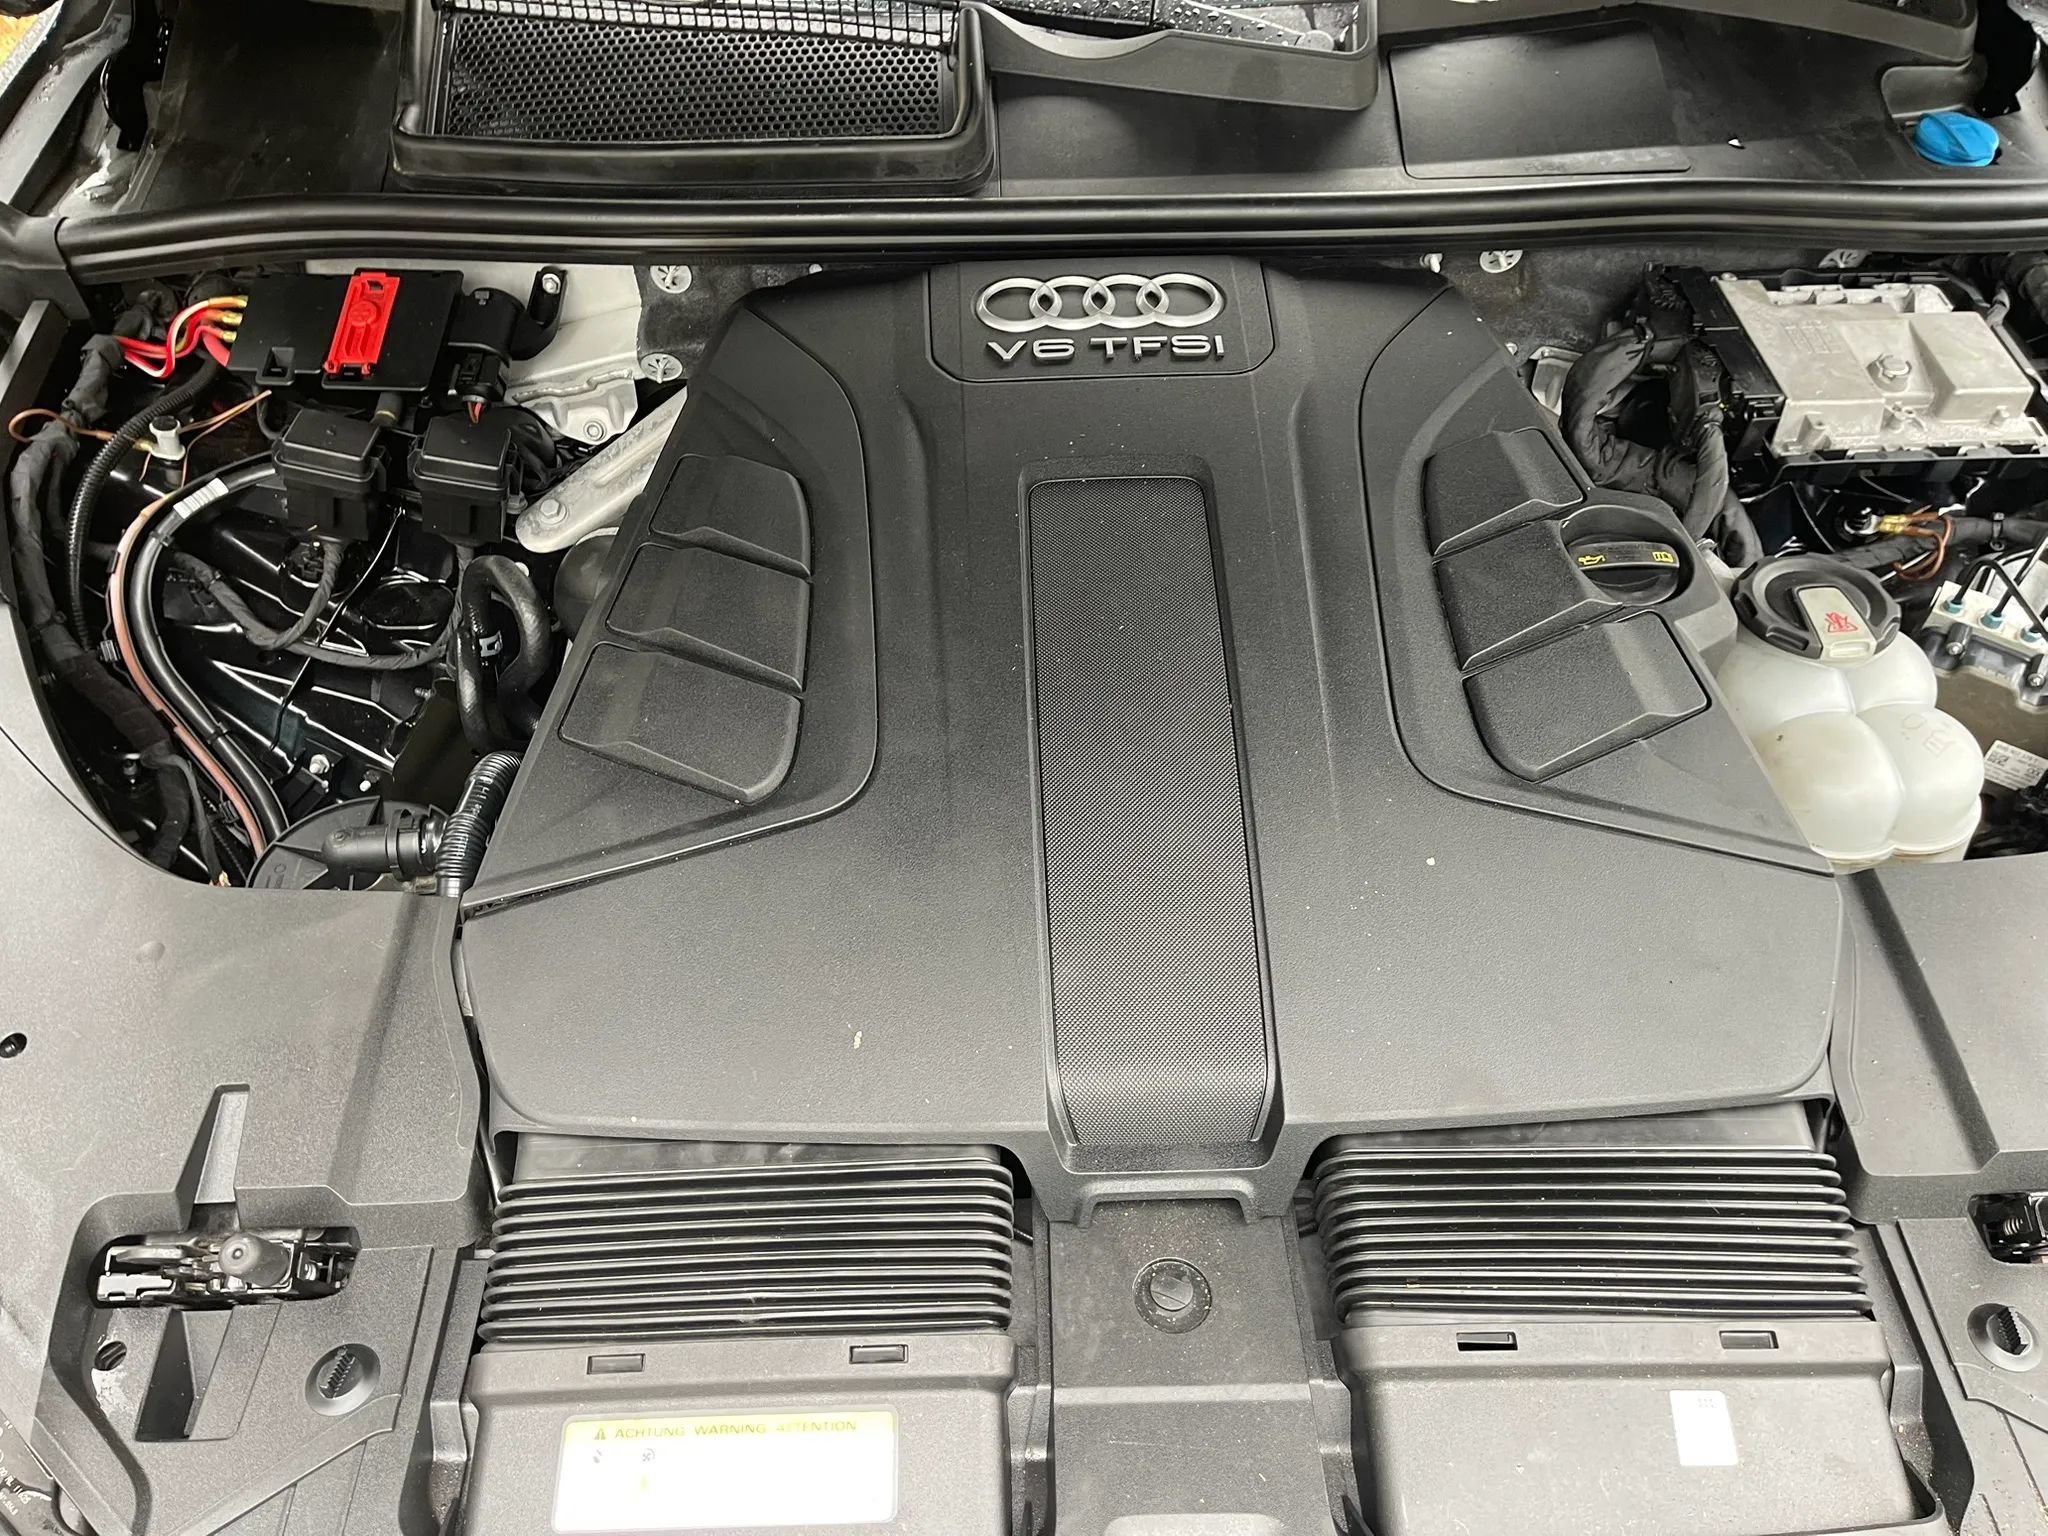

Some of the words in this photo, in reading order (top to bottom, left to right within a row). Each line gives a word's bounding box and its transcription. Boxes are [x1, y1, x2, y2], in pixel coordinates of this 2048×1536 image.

[987, 338, 1075, 361] V6
[1090, 334, 1225, 359] TFSI
[614, 1426, 685, 1438] ACHTUNG
[694, 1423, 767, 1436] WARNING
